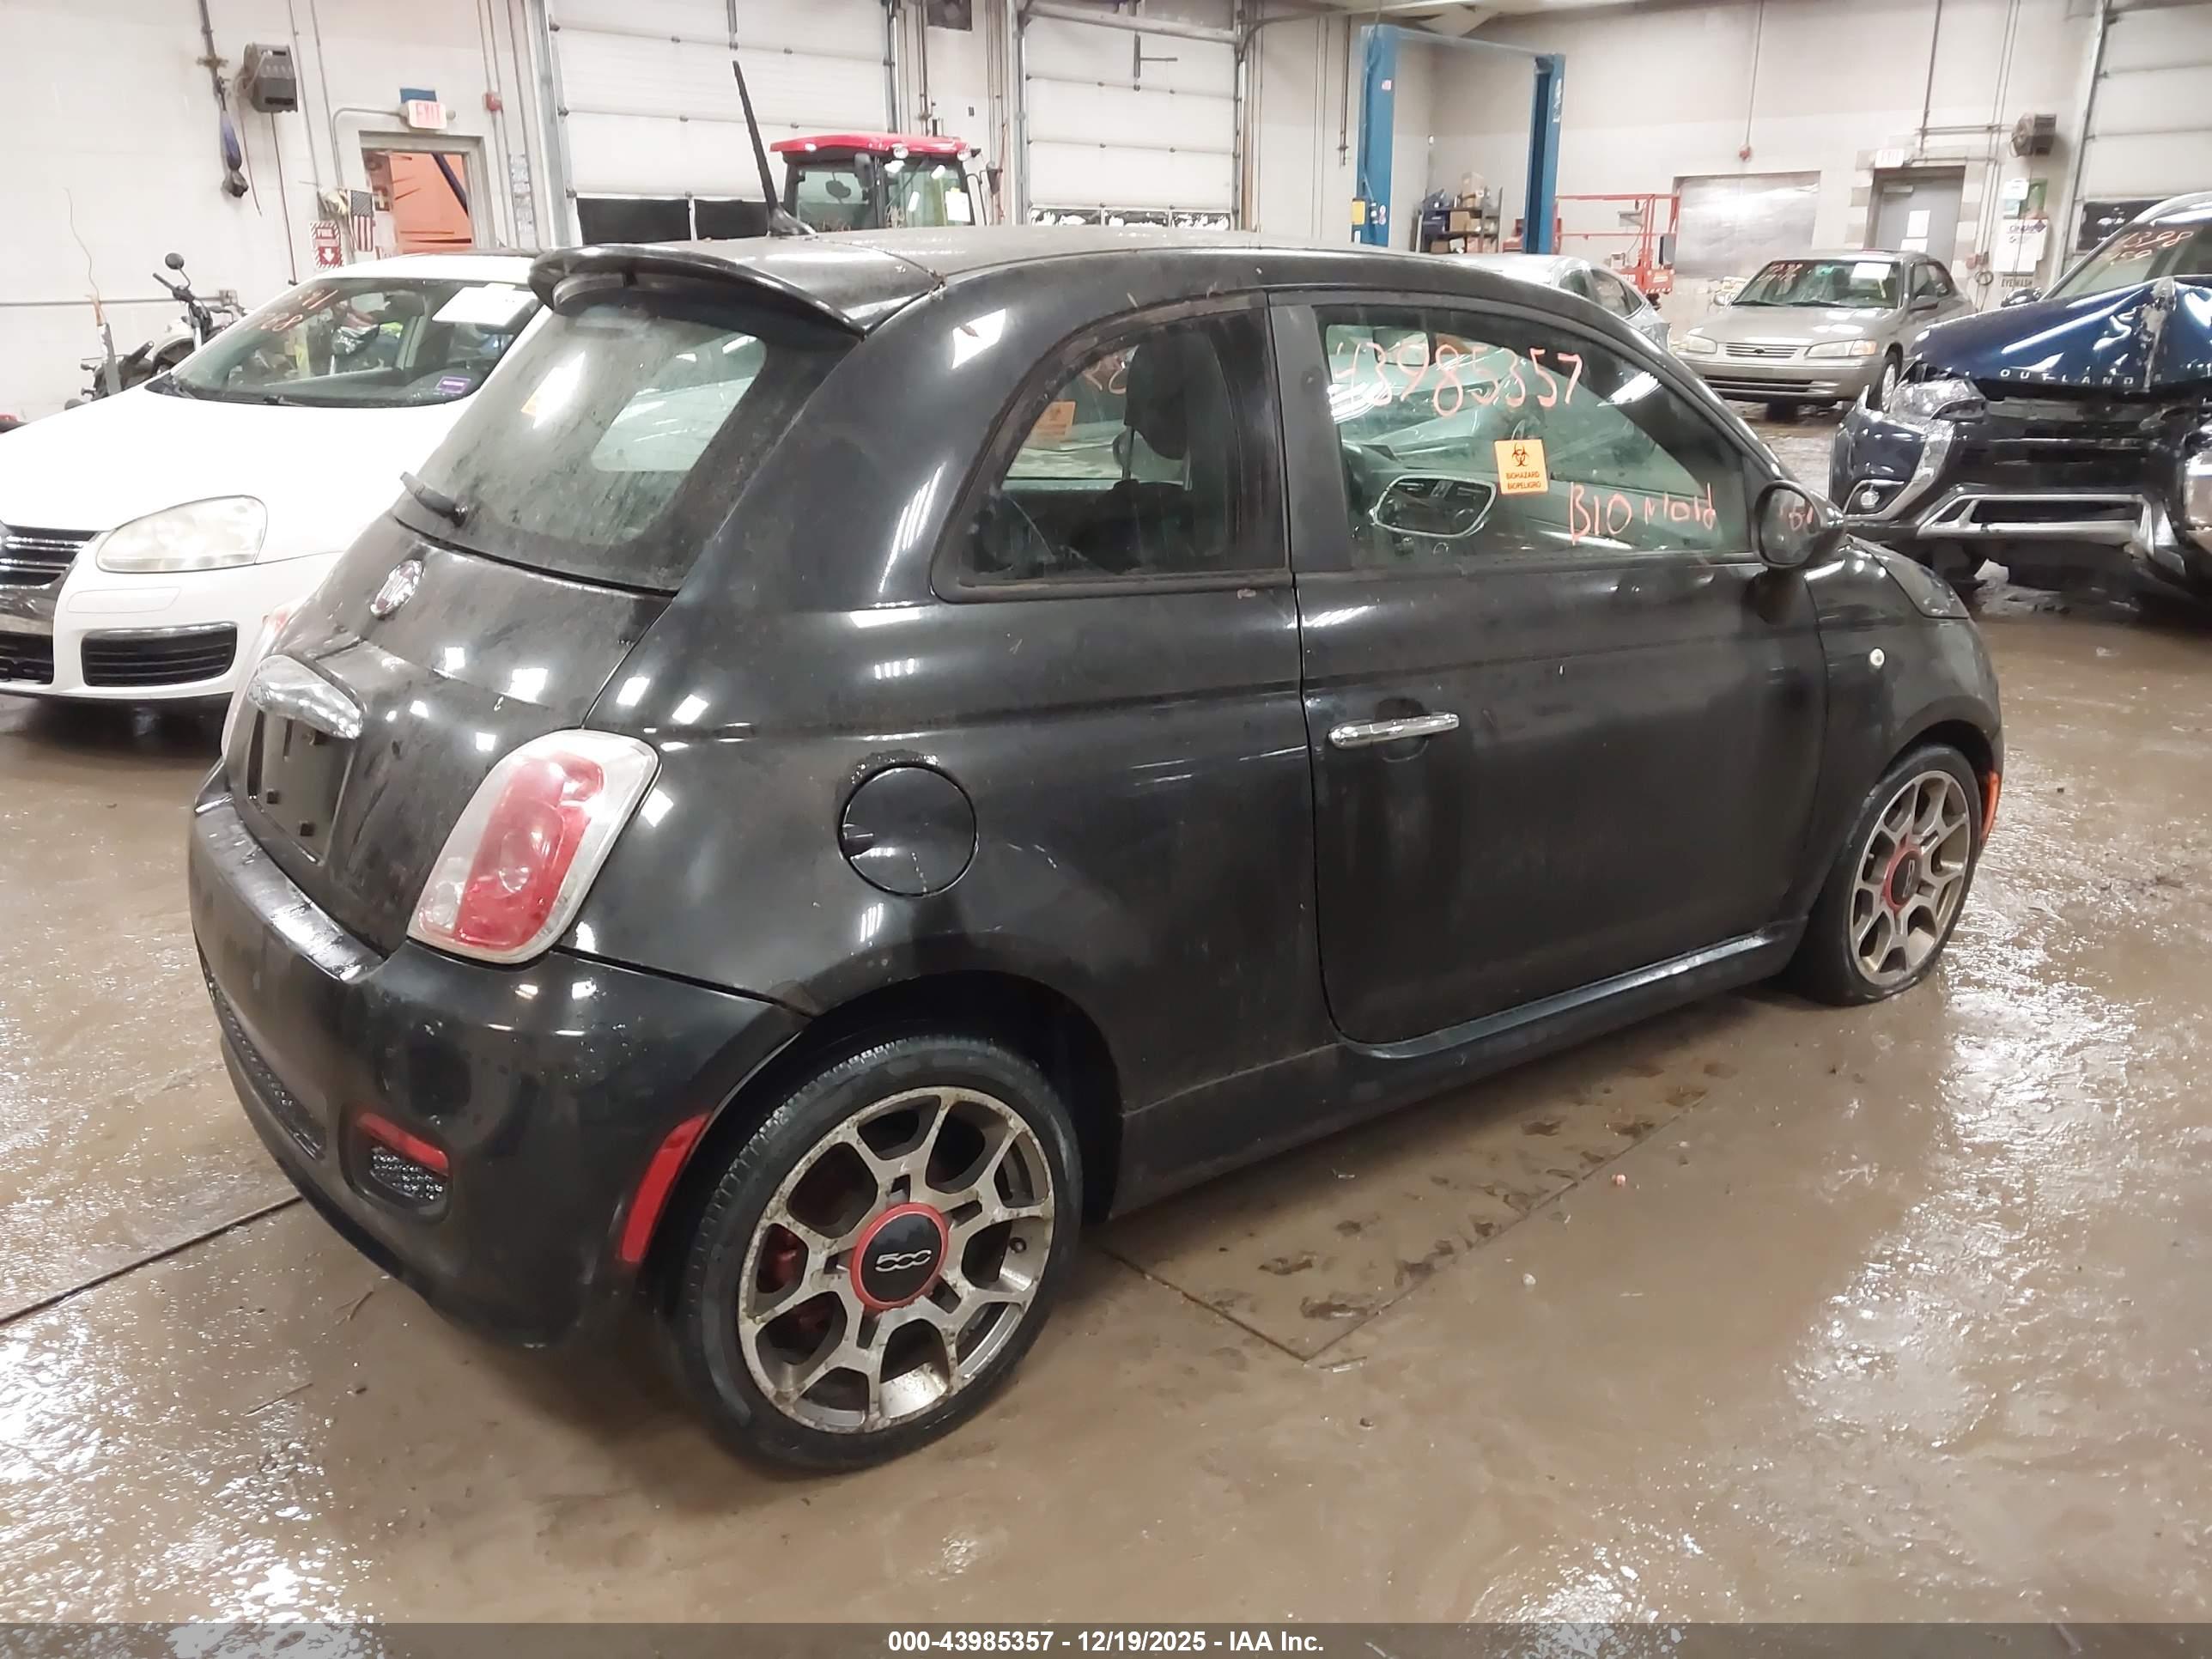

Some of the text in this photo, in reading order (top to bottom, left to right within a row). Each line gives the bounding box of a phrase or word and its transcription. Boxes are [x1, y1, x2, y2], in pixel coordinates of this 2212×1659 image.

[415, 101, 441, 123] EXIT
[1334, 342, 1583, 417] 43985357
[1505, 471, 1540, 480] BIOHAZARD
[1507, 480, 1541, 490] BIOPELIGRO
[874, 1249, 933, 1273] 500
